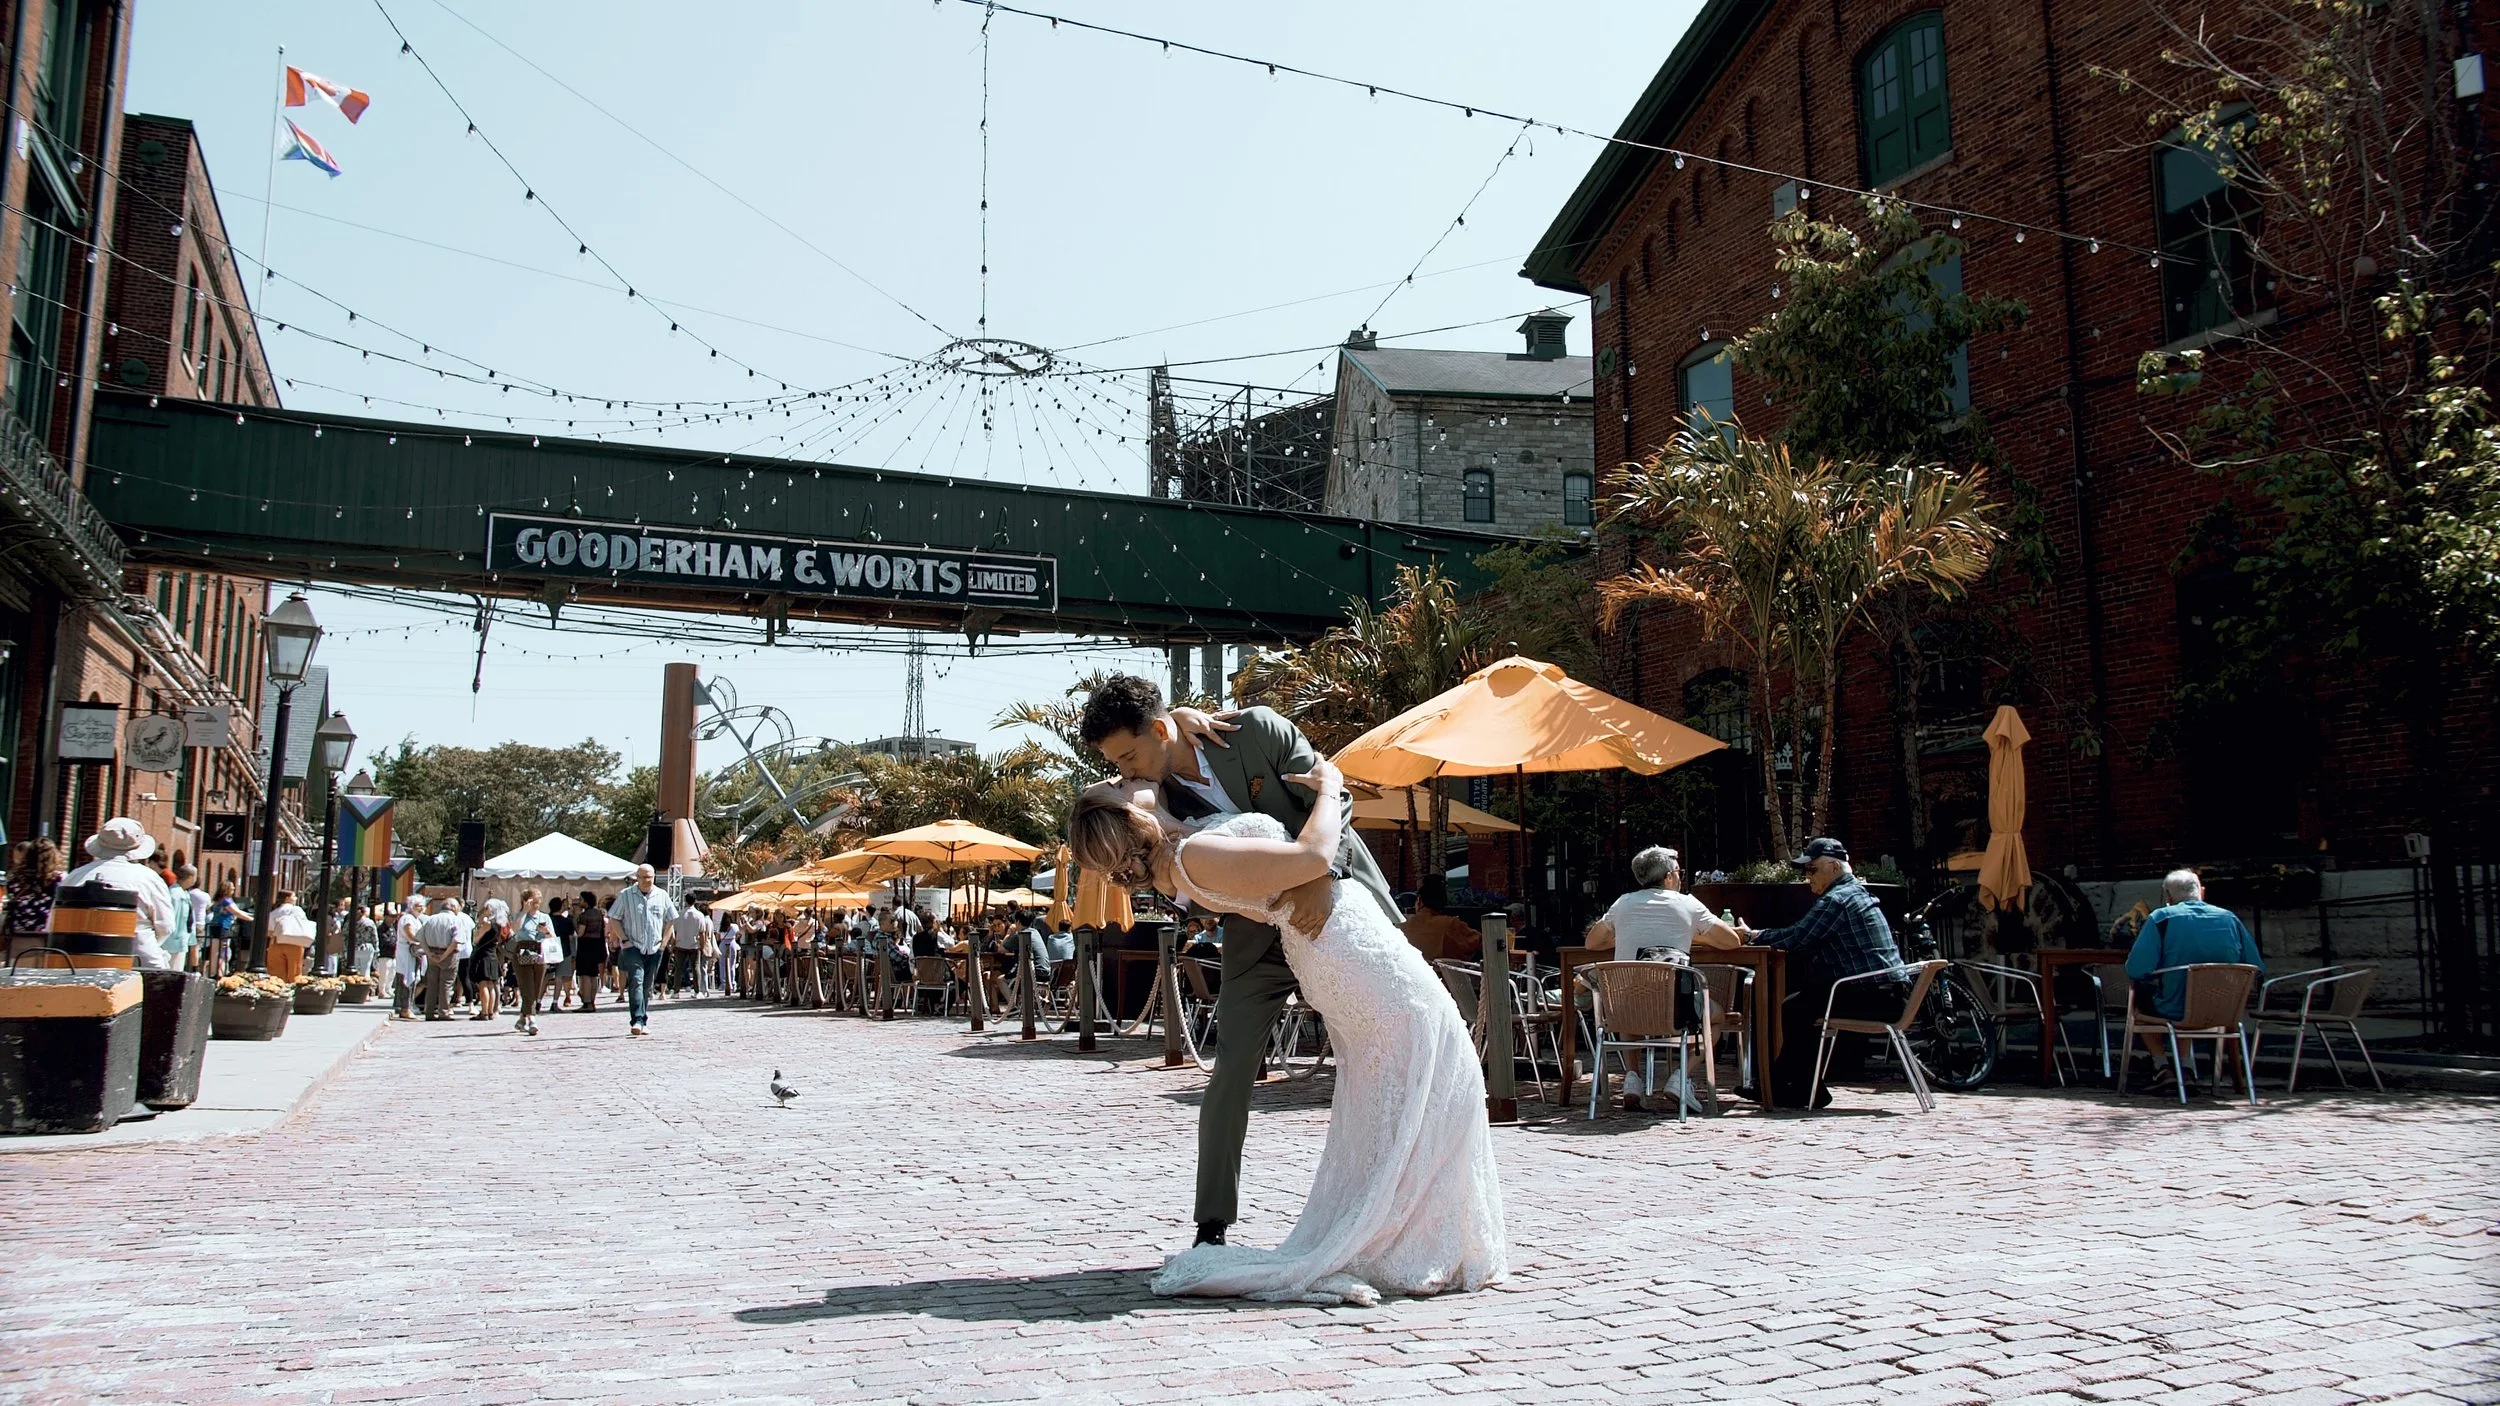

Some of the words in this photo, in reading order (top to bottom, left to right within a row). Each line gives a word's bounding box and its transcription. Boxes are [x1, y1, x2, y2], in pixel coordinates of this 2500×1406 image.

[515, 527, 782, 582] GOODERHAM
[793, 549, 827, 585] &
[829, 551, 963, 595] WORTS
[968, 569, 1038, 594] LIMITED
[1473, 779, 1481, 808] GALLE
